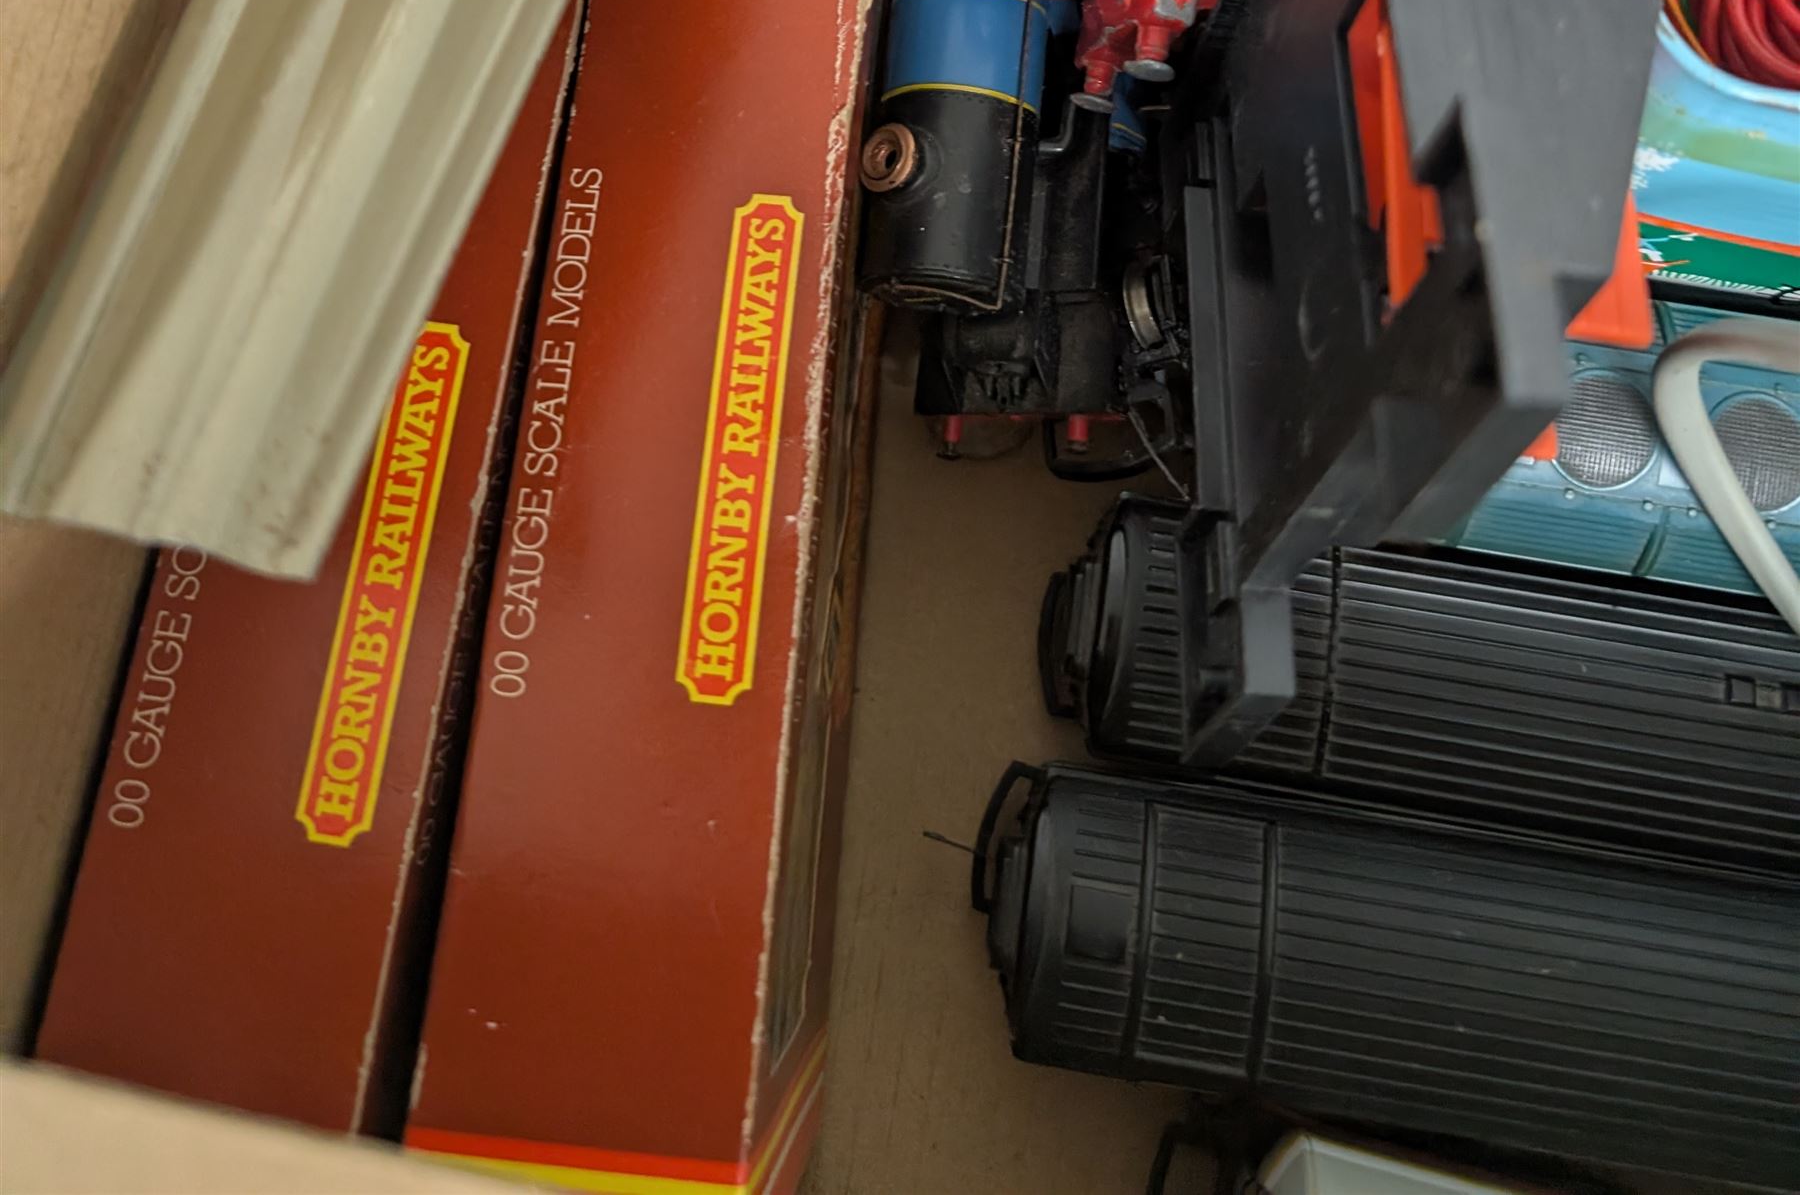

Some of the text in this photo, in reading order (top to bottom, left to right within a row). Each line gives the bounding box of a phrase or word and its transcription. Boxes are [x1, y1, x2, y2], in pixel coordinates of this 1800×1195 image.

[547, 167, 603, 327] MODELS
[524, 340, 576, 477] SCALE
[695, 217, 786, 683] HORNBY RAILWAYS
[314, 345, 450, 822] HORNBY RAILWAYS
[500, 488, 553, 640] GAUGE
[124, 610, 192, 770] GAUGE
